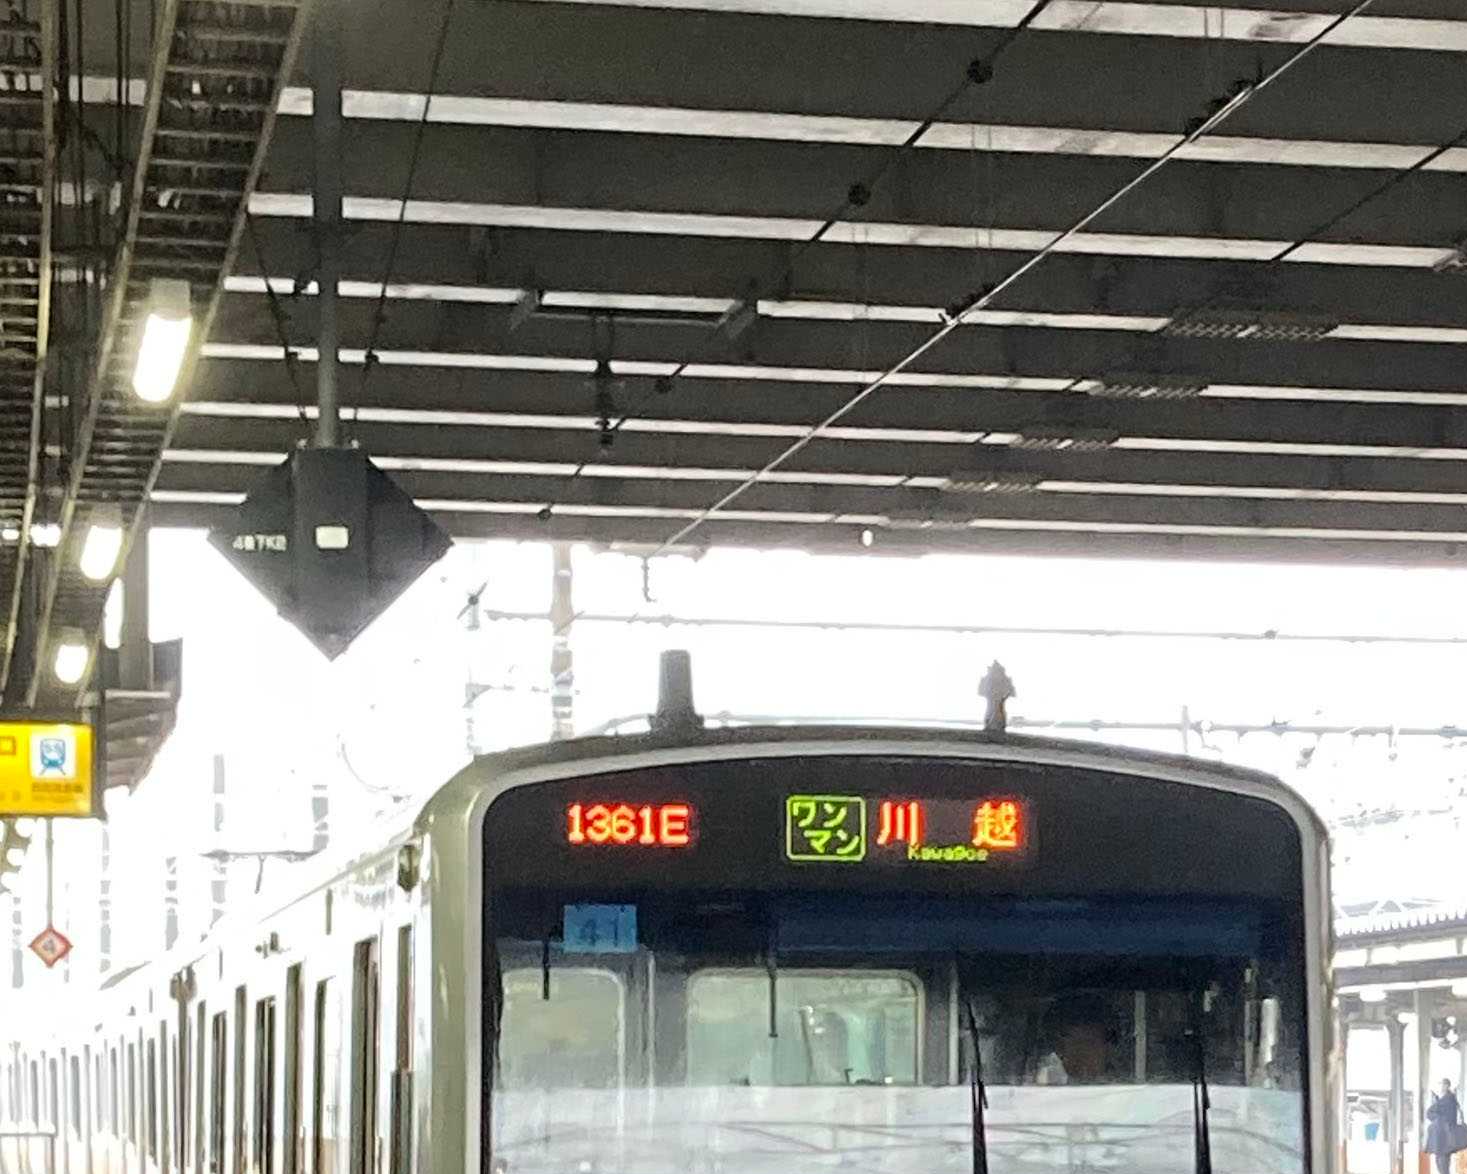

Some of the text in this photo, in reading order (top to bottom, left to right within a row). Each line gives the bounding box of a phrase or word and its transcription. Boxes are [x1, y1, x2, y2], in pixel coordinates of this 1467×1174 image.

[567, 802, 689, 845] 1361E
[792, 801, 848, 828] ワン
[876, 800, 1018, 847] 川越
[803, 830, 860, 854] マン
[907, 845, 989, 861] Kawagoe
